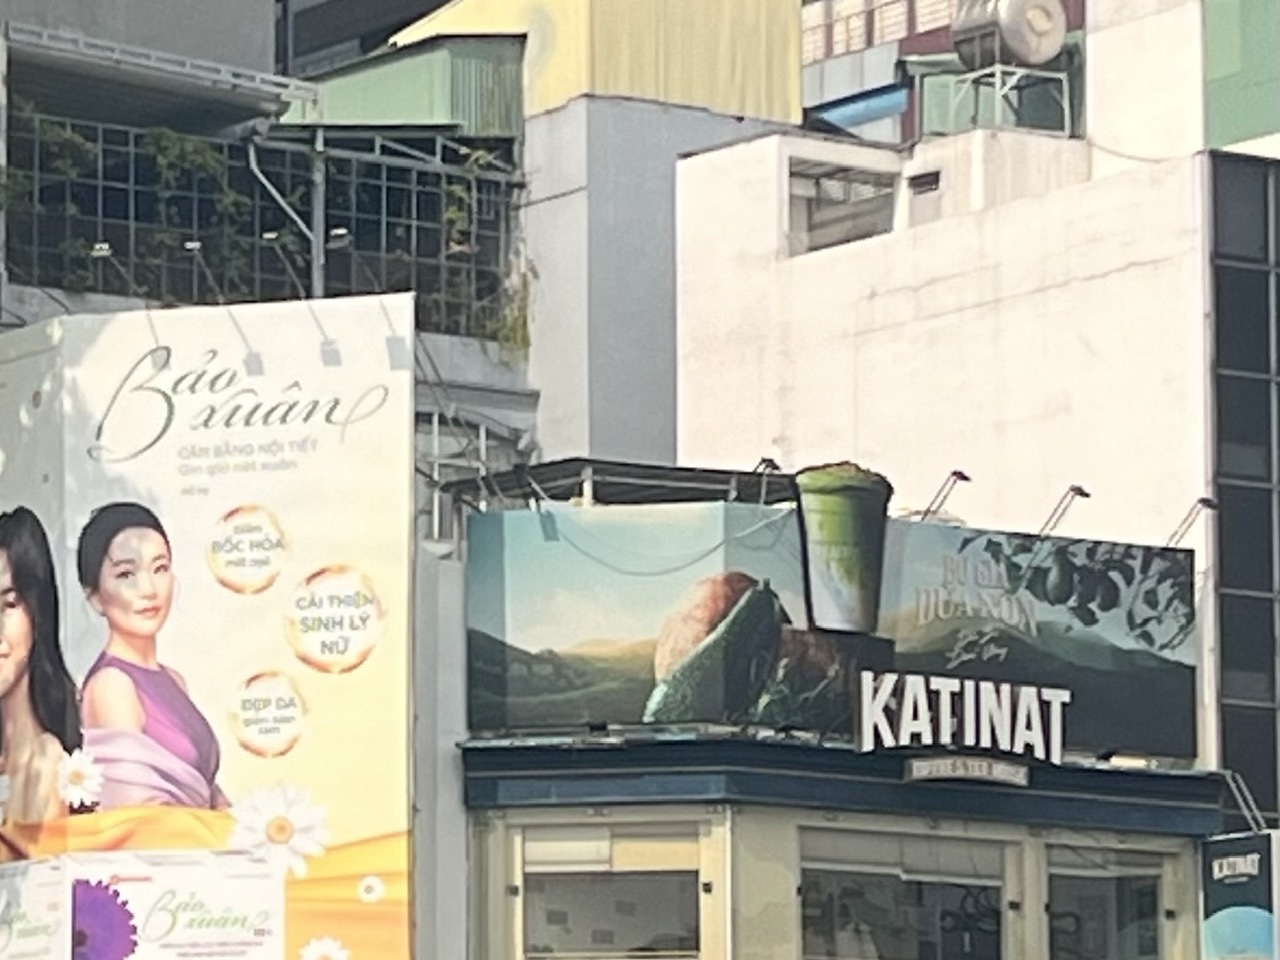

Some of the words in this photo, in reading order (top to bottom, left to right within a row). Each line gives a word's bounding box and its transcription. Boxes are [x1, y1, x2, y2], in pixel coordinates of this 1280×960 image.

[87, 345, 238, 464] Bảo
[189, 380, 389, 444] xuân
[299, 615, 344, 633] SINH
[349, 611, 371, 631] LÝ
[860, 670, 1072, 766] KATINAT
